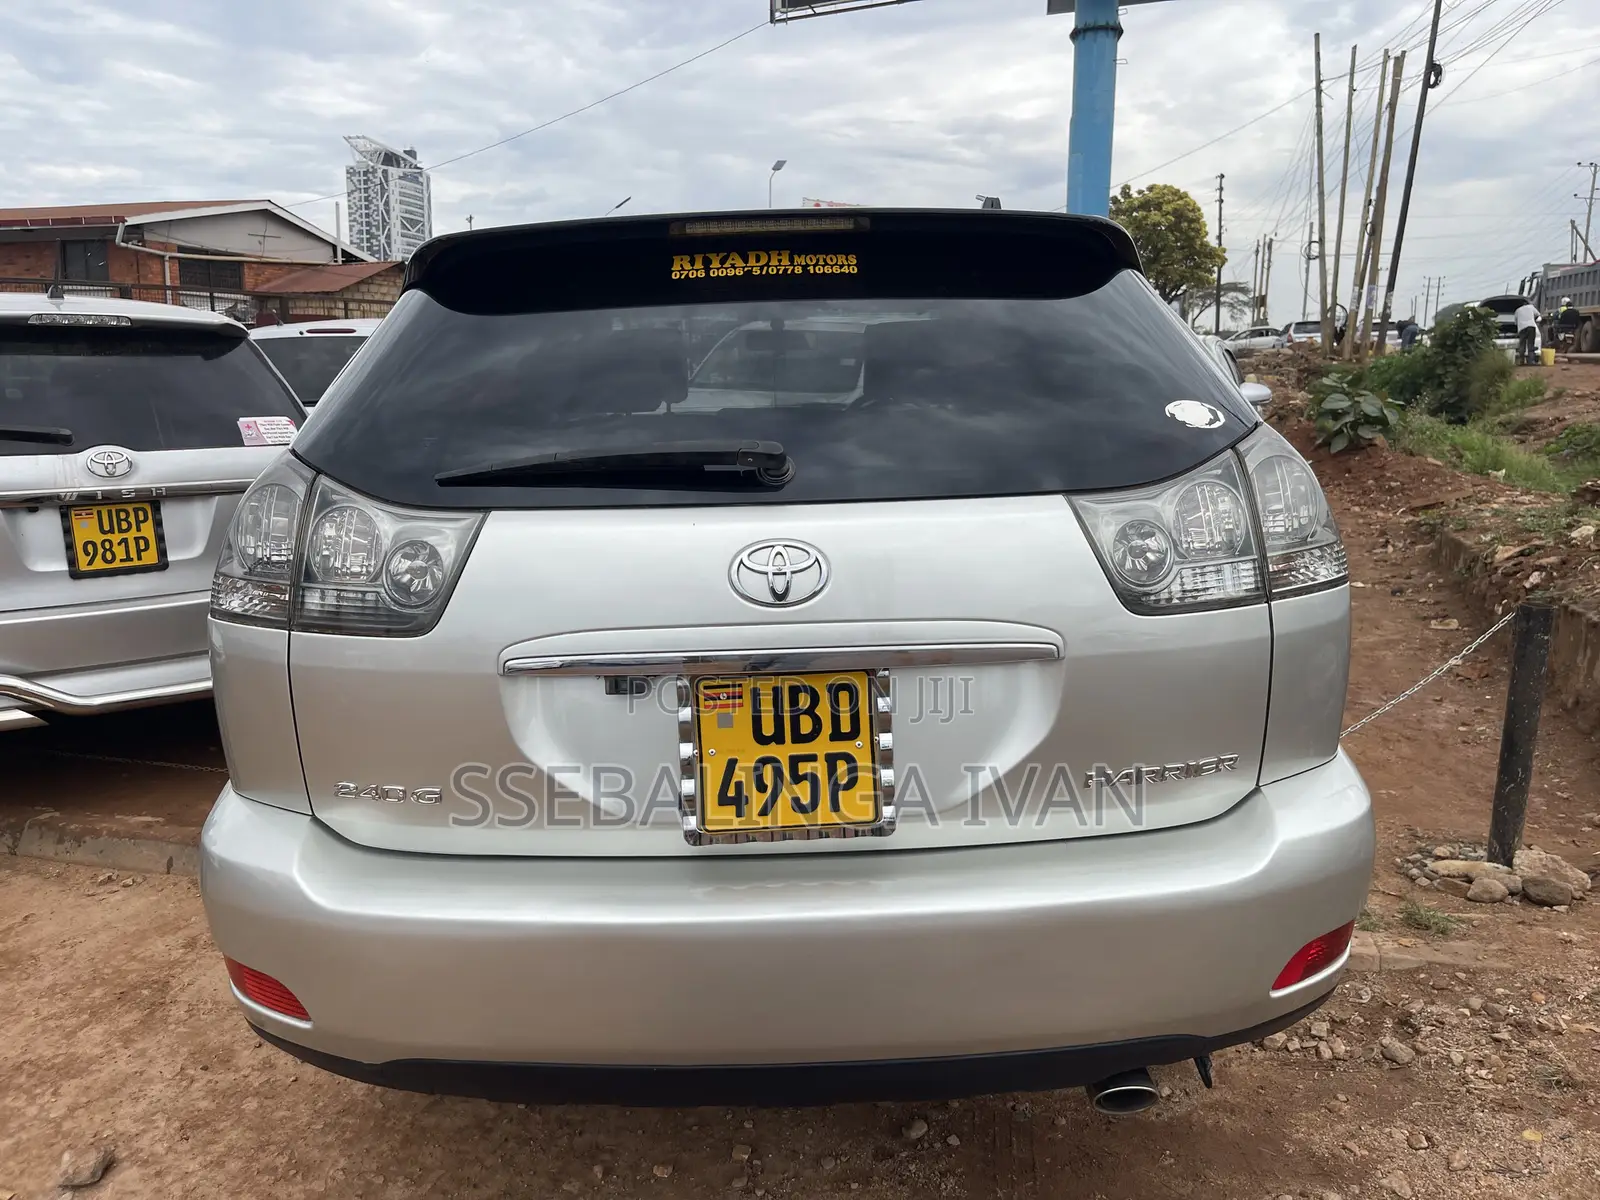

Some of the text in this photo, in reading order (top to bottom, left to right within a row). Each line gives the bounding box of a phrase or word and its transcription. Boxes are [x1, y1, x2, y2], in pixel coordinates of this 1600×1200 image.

[671, 250, 857, 271] RIYADH MOTORS
[671, 269, 706, 279] 0706
[807, 265, 857, 274] 106640
[96, 507, 149, 535] UBP
[82, 536, 150, 566] 981P
[716, 751, 860, 818] 495P
[1083, 752, 1240, 789] HARRIER
